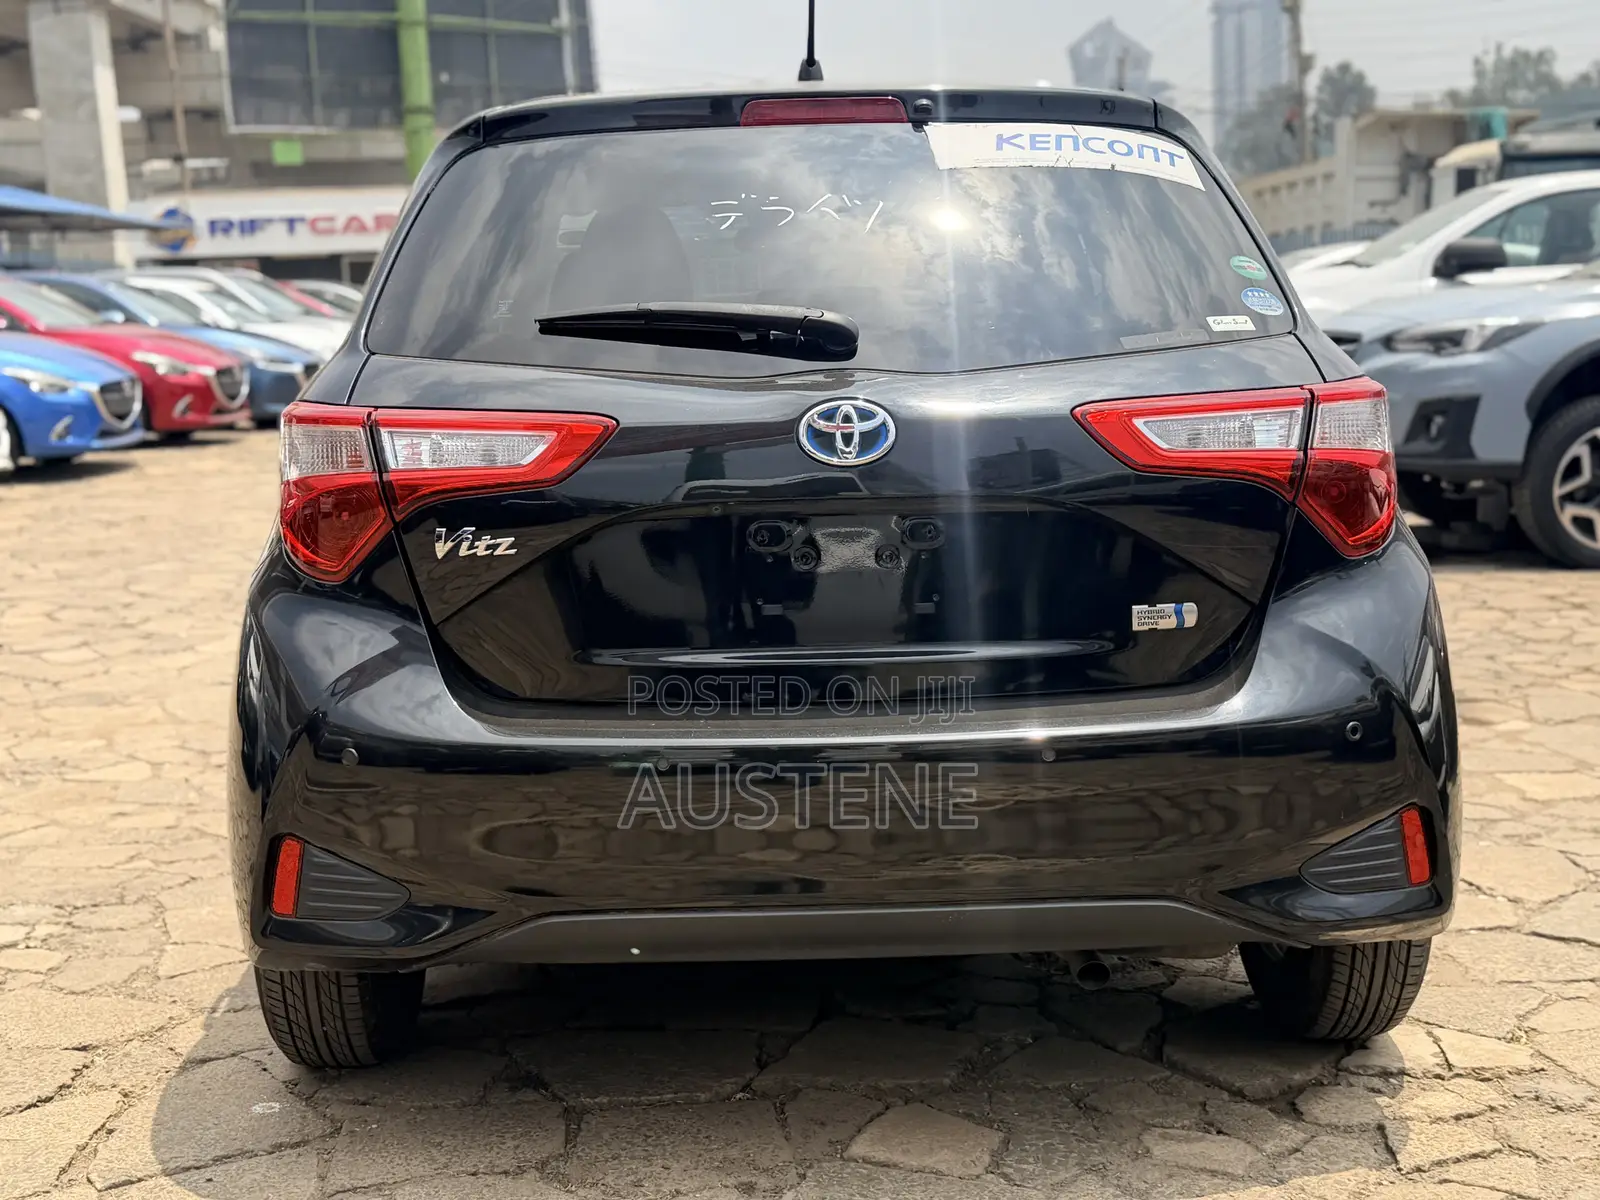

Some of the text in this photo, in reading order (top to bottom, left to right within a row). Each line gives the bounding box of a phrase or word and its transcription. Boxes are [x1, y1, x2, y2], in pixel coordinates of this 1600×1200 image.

[434, 526, 518, 560] Vitz
[1136, 608, 1166, 616] HYBRID
[1137, 614, 1173, 622] SYNERGY
